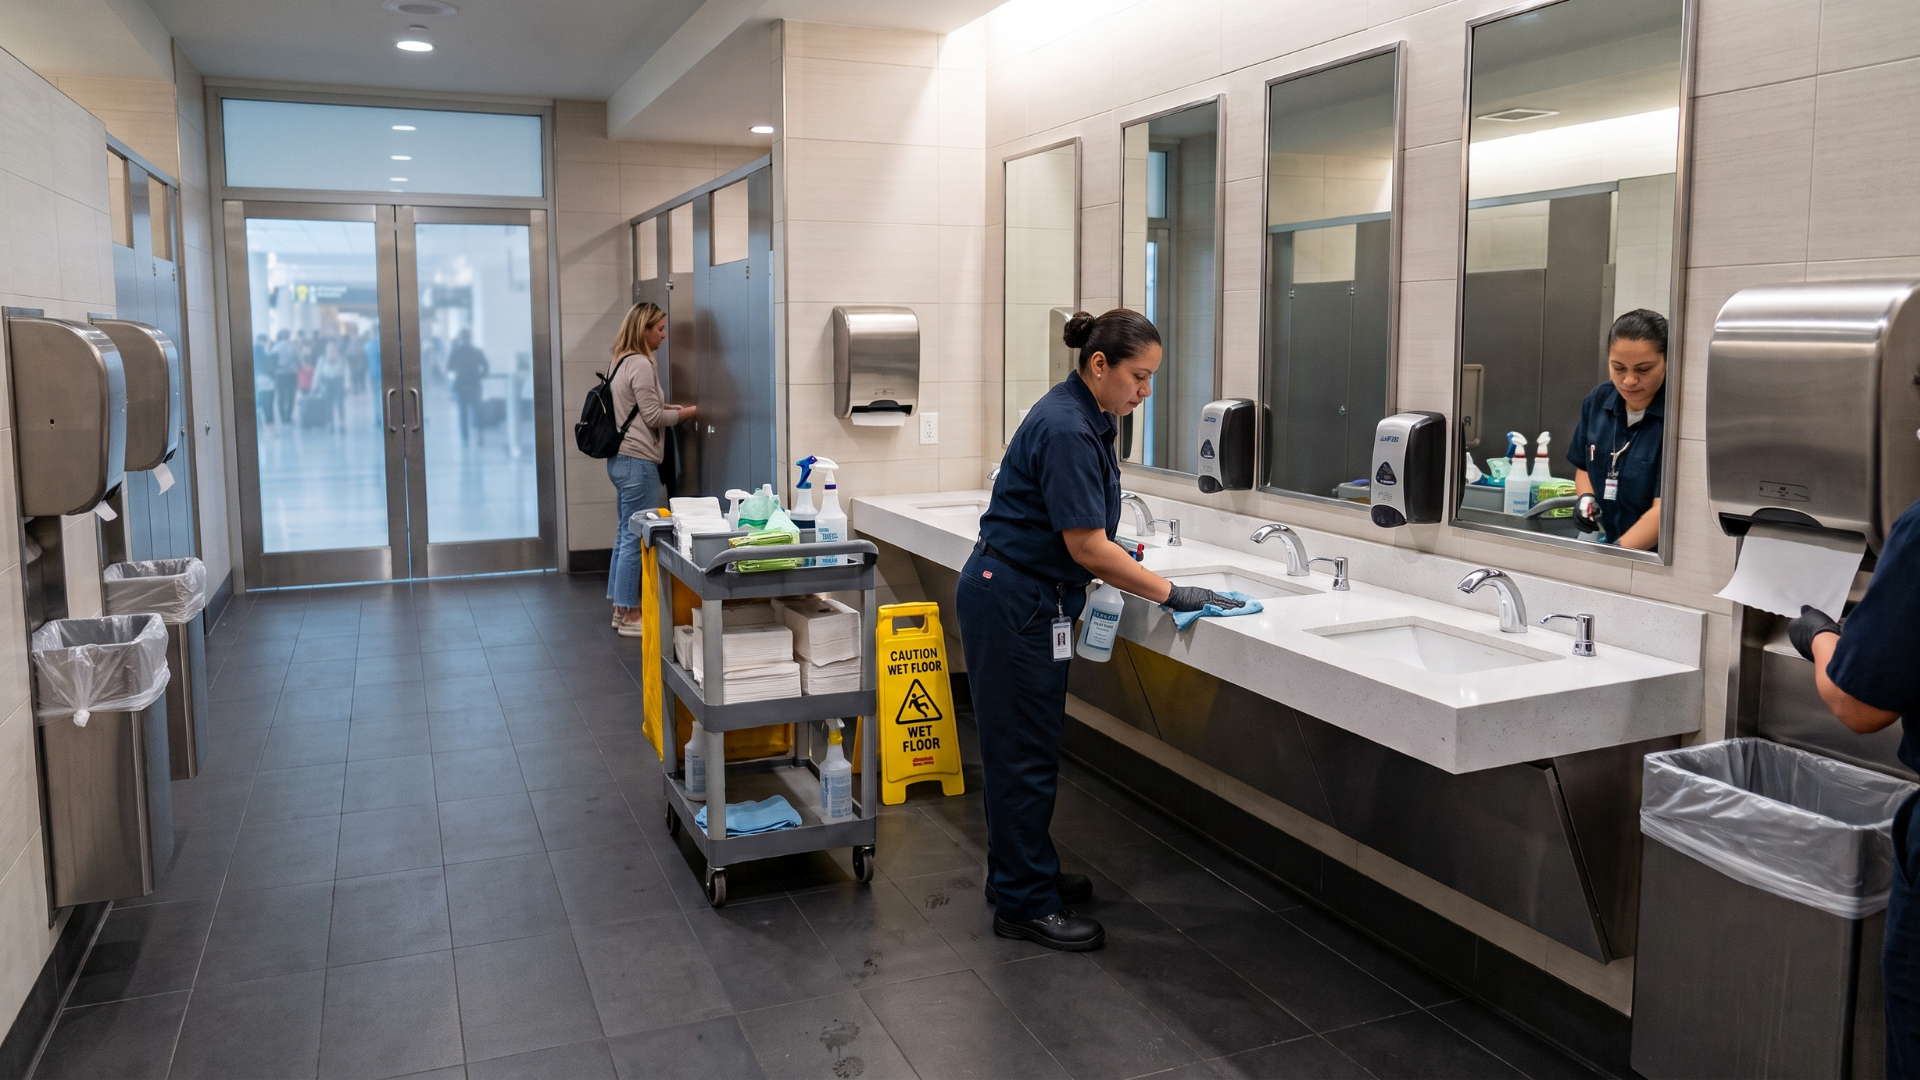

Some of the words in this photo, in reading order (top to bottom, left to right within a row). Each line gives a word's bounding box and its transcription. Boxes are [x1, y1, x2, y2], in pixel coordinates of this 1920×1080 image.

[890, 648, 938, 662] CAUTION
[887, 663, 909, 676] WET
[911, 660, 942, 674] FLOOR
[907, 725, 933, 738] WET
[902, 737, 941, 753] FLOOR
